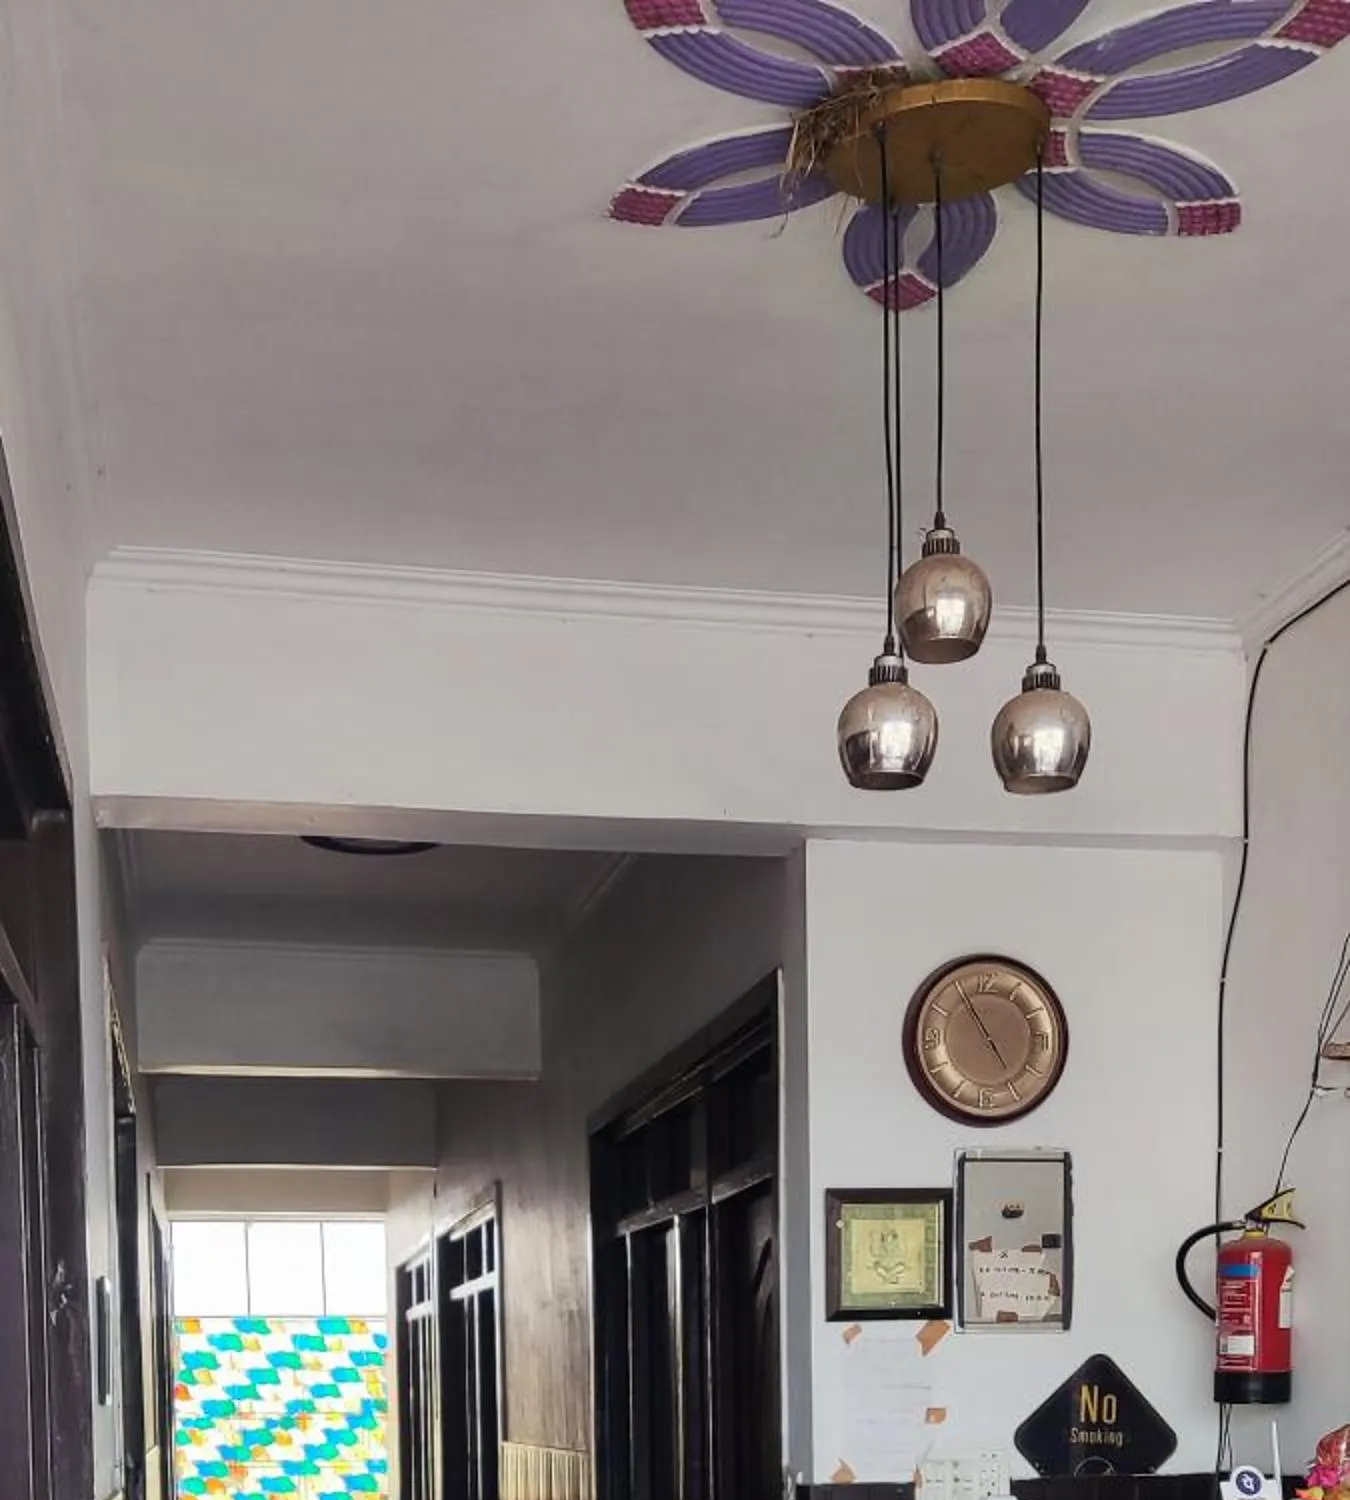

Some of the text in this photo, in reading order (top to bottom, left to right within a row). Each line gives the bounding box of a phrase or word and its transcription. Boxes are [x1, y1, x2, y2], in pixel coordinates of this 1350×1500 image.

[976, 973, 999, 994] 12
[925, 1028, 941, 1049] 9
[1036, 1032, 1050, 1051] 3
[977, 1088, 994, 1110] 6
[1079, 1384, 1118, 1425] No
[1070, 1427, 1124, 1448] Smoking
